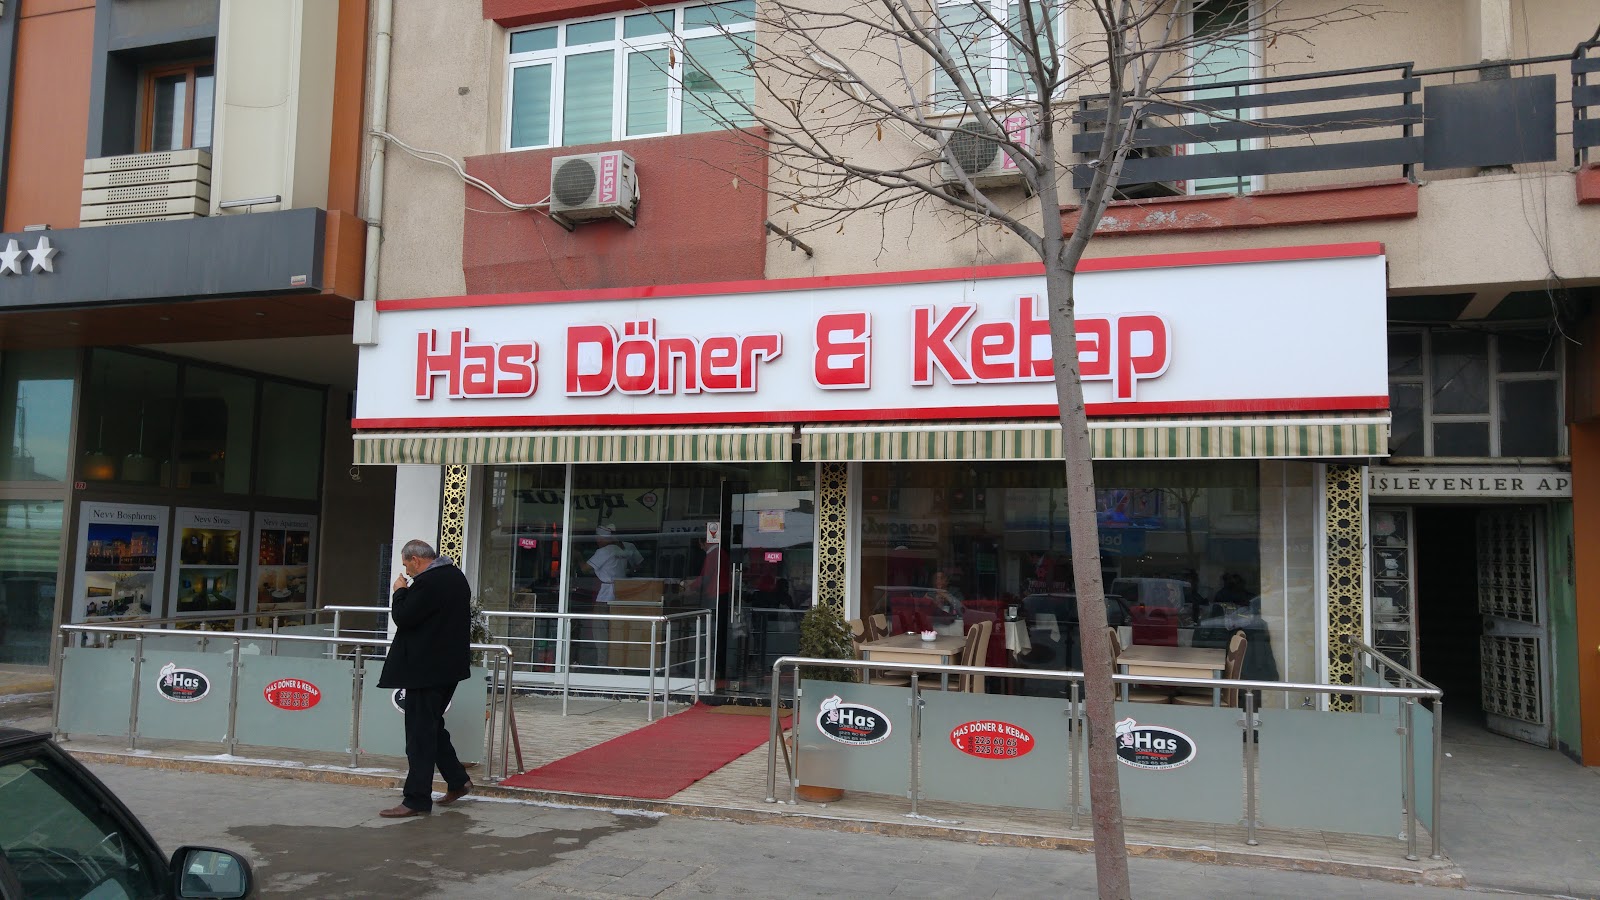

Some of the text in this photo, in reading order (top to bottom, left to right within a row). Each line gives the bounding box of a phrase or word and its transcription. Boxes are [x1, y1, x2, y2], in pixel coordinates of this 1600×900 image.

[602, 156, 615, 202] VESTEL
[416, 295, 1170, 402] Has Döner & Kebap
[1370, 475, 1569, 491] İŞLEYENLER AP
[117, 510, 157, 522] Bosphorus
[173, 673, 199, 687] Has
[839, 709, 875, 727] Has
[953, 721, 1030, 742] HAS DÖNER & KEBAP
[975, 736, 1017, 747] 225 60 65
[1135, 732, 1177, 751] Has
[975, 746, 1017, 756] 225 65 65
